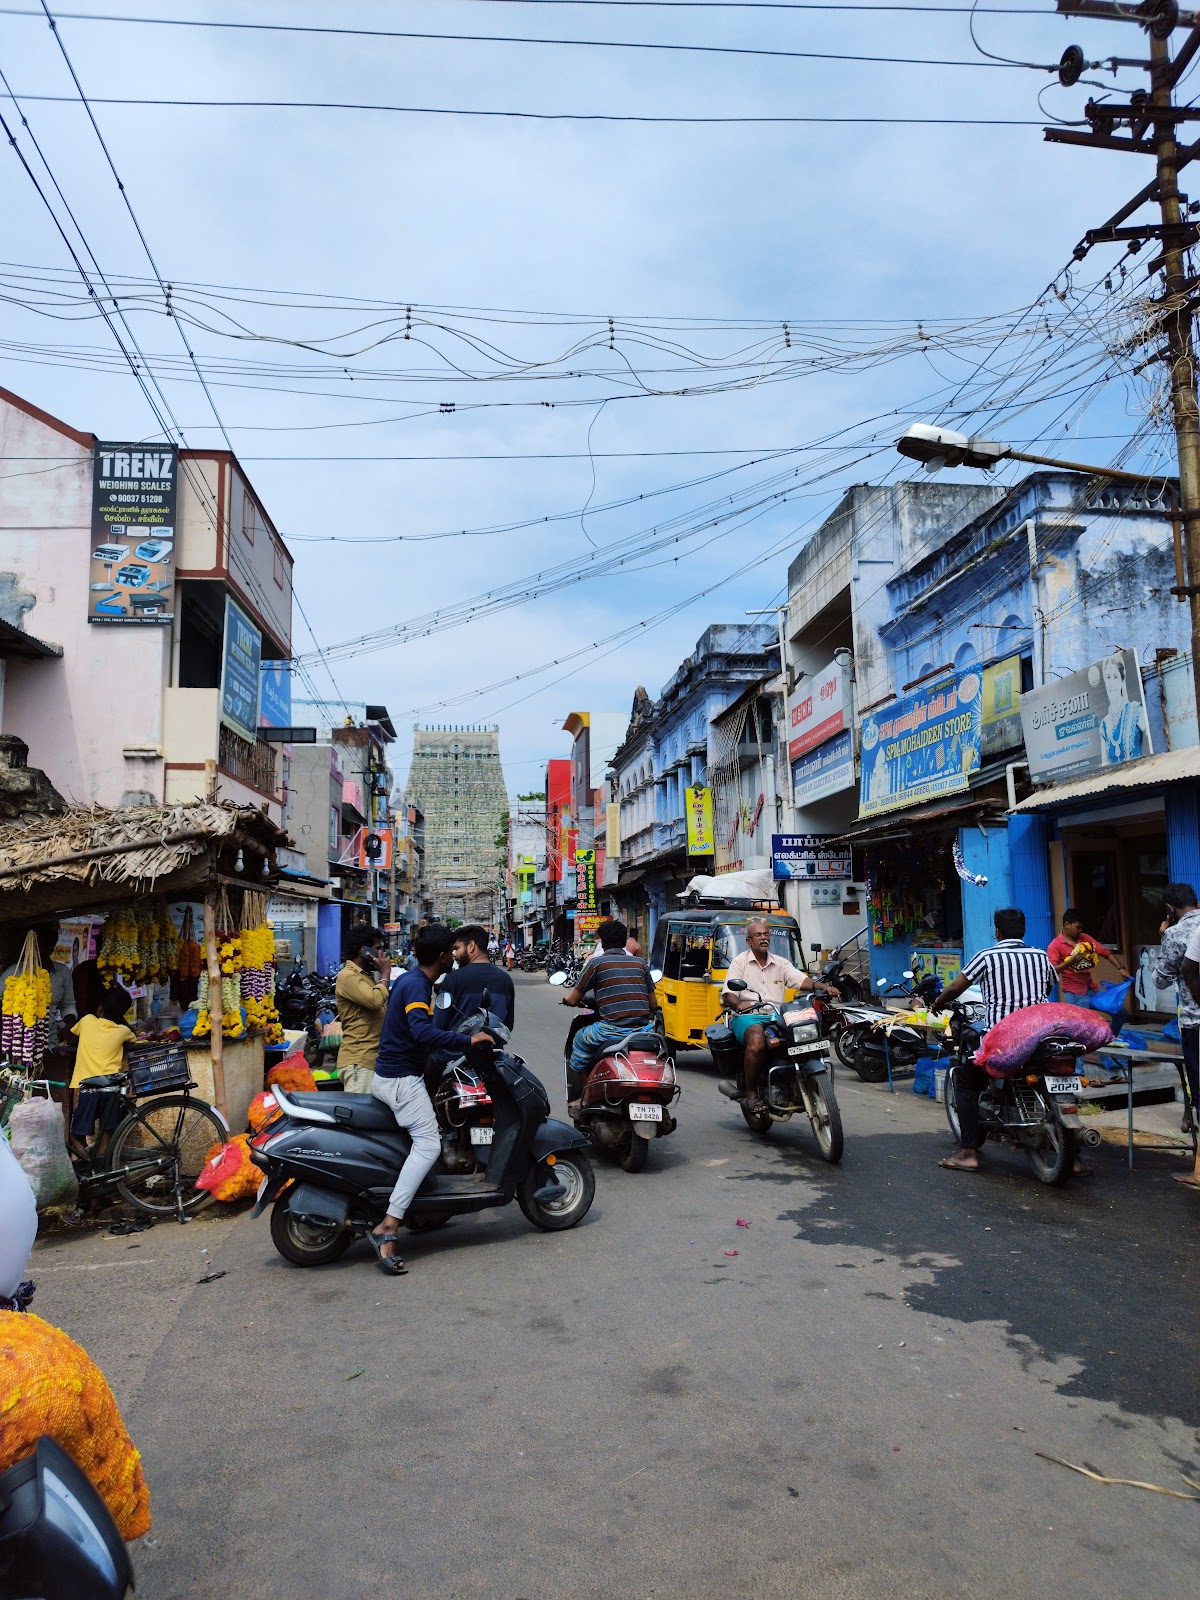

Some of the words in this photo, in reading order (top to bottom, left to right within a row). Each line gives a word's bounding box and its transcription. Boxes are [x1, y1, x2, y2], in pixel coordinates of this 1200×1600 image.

[99, 451, 173, 479] TRENZ
[99, 480, 139, 490] WEIGHING
[140, 481, 171, 491] SCALES
[117, 494, 139, 503] 90037
[141, 495, 163, 503] 51208
[237, 620, 253, 657] TRENZ
[792, 700, 812, 725] USHA
[927, 685, 958, 718] ஸ்டோர்
[901, 725, 942, 756] MOHAIDEEN
[944, 712, 972, 739] STORE
[796, 783, 812, 797] POPULAR
[813, 774, 832, 790] ELECTRIC
[832, 766, 849, 781] STORES
[1050, 1083, 1079, 1091] 2029
